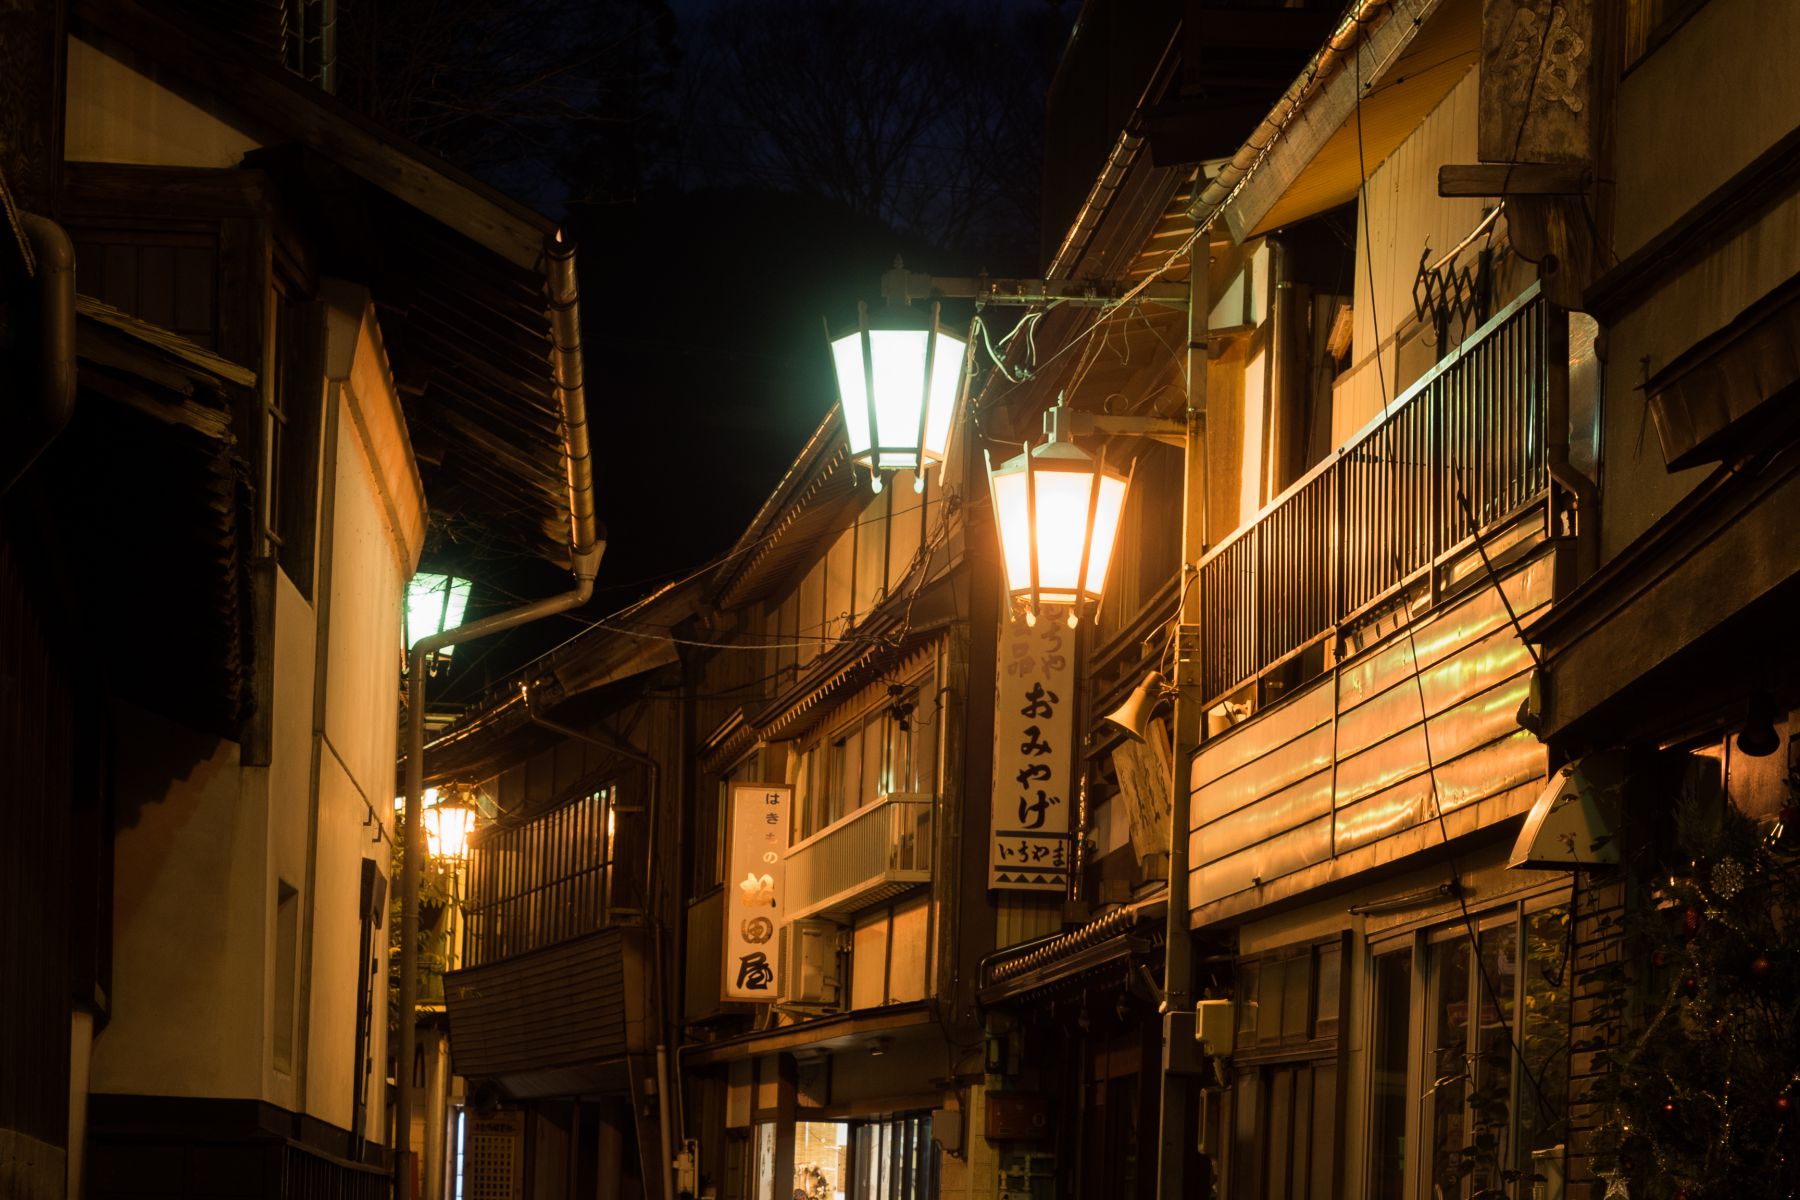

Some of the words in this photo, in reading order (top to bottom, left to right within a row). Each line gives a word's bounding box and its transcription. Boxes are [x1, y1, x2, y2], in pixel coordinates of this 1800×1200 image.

[1016, 681, 1061, 829] おみやげ
[762, 792, 781, 864] はきもの
[998, 839, 1065, 867] いちやま
